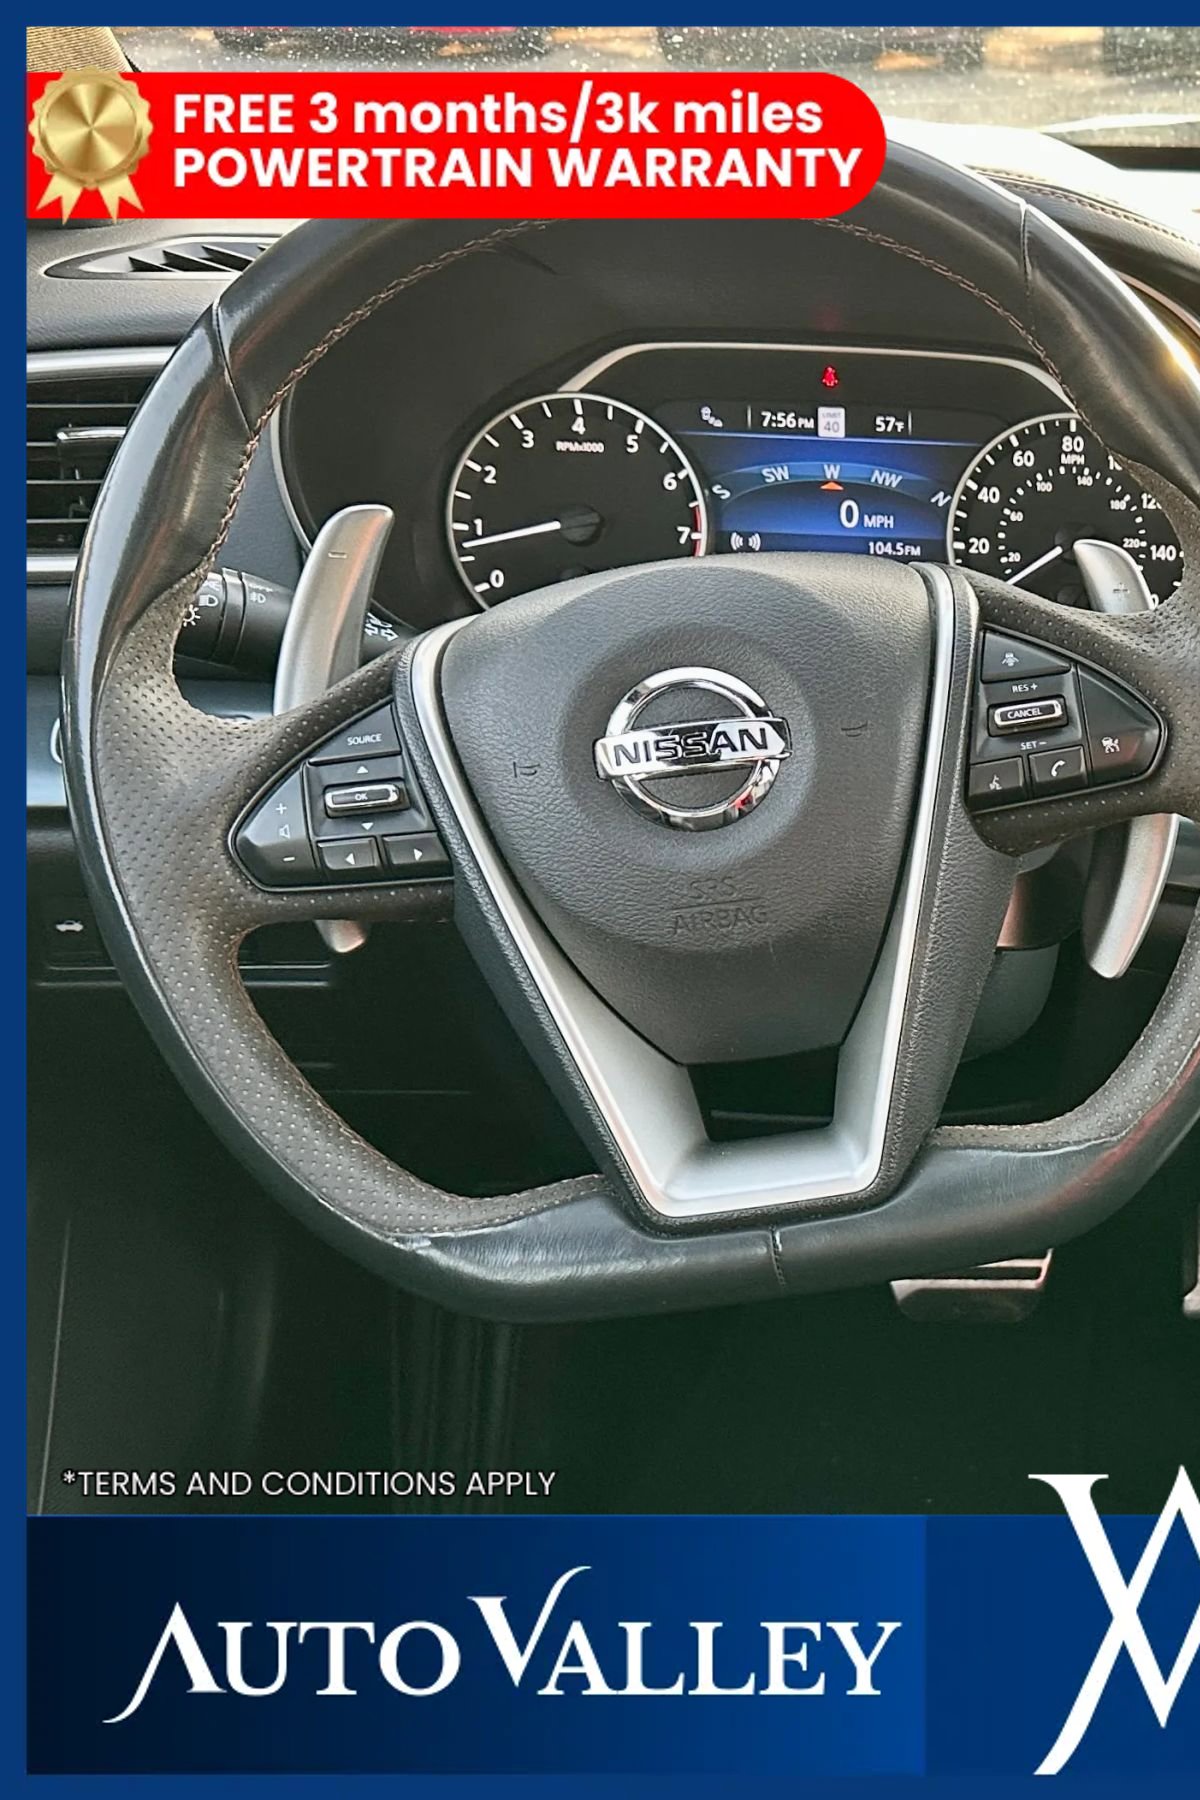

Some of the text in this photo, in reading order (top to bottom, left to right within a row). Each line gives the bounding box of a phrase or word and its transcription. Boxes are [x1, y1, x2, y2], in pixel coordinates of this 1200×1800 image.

[571, 416, 586, 435] 4
[823, 421, 840, 433] 40
[521, 430, 534, 449] 3
[626, 434, 639, 453] 5
[1061, 435, 1085, 453] 80
[1013, 451, 1035, 467] 60
[1060, 452, 1085, 465] MPH
[484, 465, 497, 485] 2
[663, 473, 678, 491] 6
[711, 463, 952, 507] S SW W NW N
[1036, 481, 1053, 493] 100
[978, 486, 1000, 504] 40
[840, 499, 895, 529] 0 MPH
[1009, 510, 1024, 523] 60
[473, 519, 482, 536] 1
[677, 526, 691, 544] 7
[968, 537, 990, 554] 20
[1122, 537, 1141, 549] 220
[1007, 551, 1021, 563] 20
[1150, 544, 1177, 561] 140
[490, 570, 505, 588] 0
[1011, 683, 1029, 694] RES
[1007, 706, 1043, 719] CANCEL
[347, 732, 382, 746] SOURCE
[612, 726, 769, 768] NISSAN
[1020, 740, 1037, 751] SET
[354, 792, 368, 801] OK
[671, 904, 768, 936] AIRBAG
